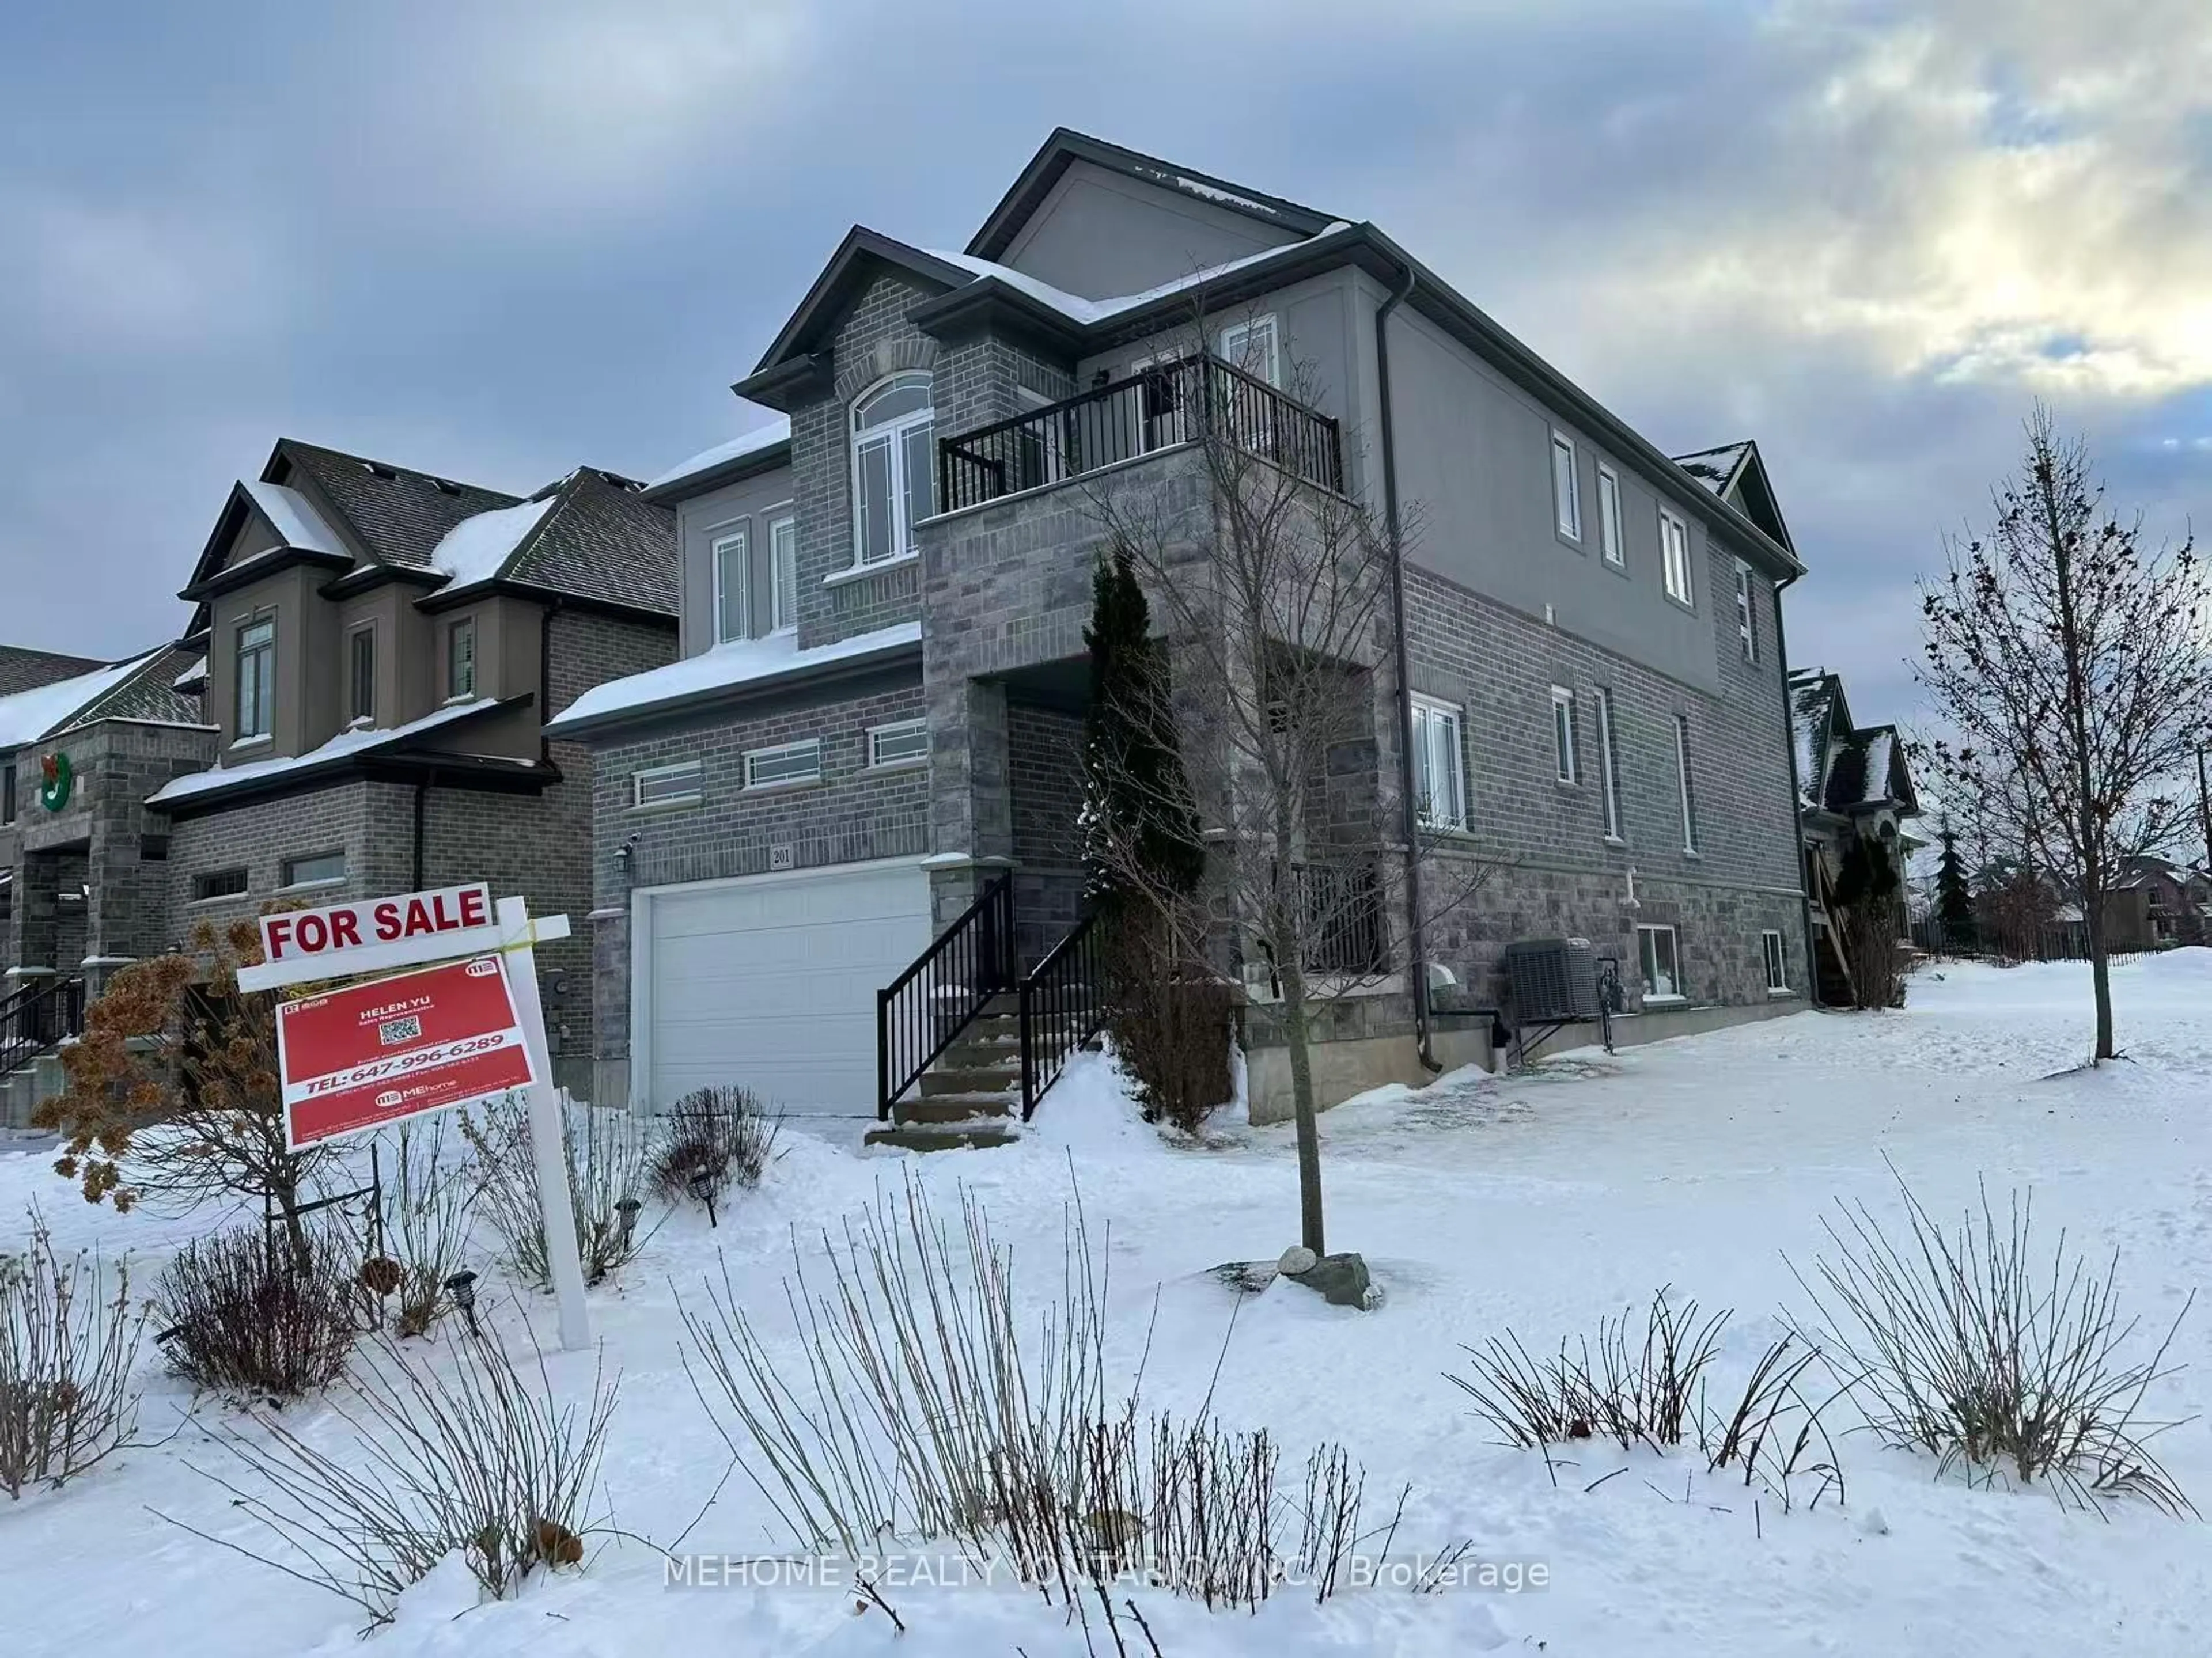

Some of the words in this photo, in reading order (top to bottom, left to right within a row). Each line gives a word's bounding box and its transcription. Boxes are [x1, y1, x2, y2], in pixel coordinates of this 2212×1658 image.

[773, 849, 790, 864] 201
[267, 909, 363, 958] FOR
[374, 889, 486, 940] SALE
[360, 1001, 407, 1020] HELEN
[410, 996, 431, 1007] YU
[306, 1076, 348, 1094] TEL:
[350, 1035, 505, 1082] 647-996-6289
[403, 1080, 457, 1097] MEhome
